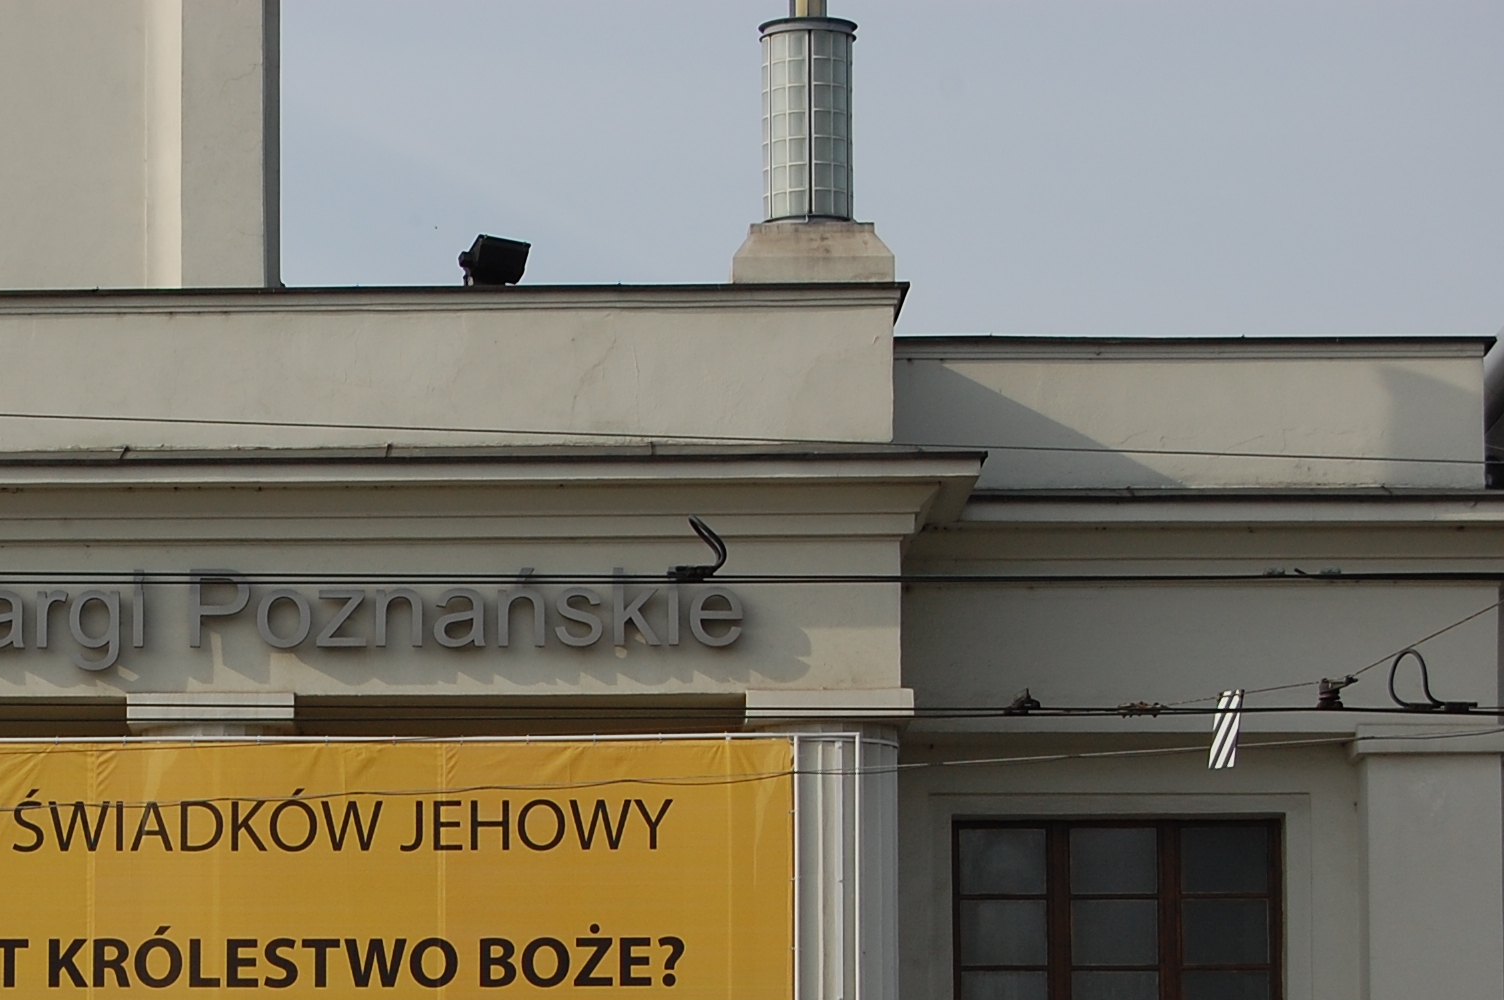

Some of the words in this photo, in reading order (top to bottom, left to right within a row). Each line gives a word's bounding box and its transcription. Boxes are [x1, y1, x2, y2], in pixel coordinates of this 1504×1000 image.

[187, 567, 747, 650] Poznańskie
[12, 788, 384, 853] ŚWIADKÓW
[399, 799, 674, 852] JEHOWY
[48, 925, 458, 989] KRÓLESTWO
[479, 923, 685, 988] BOŻE?
